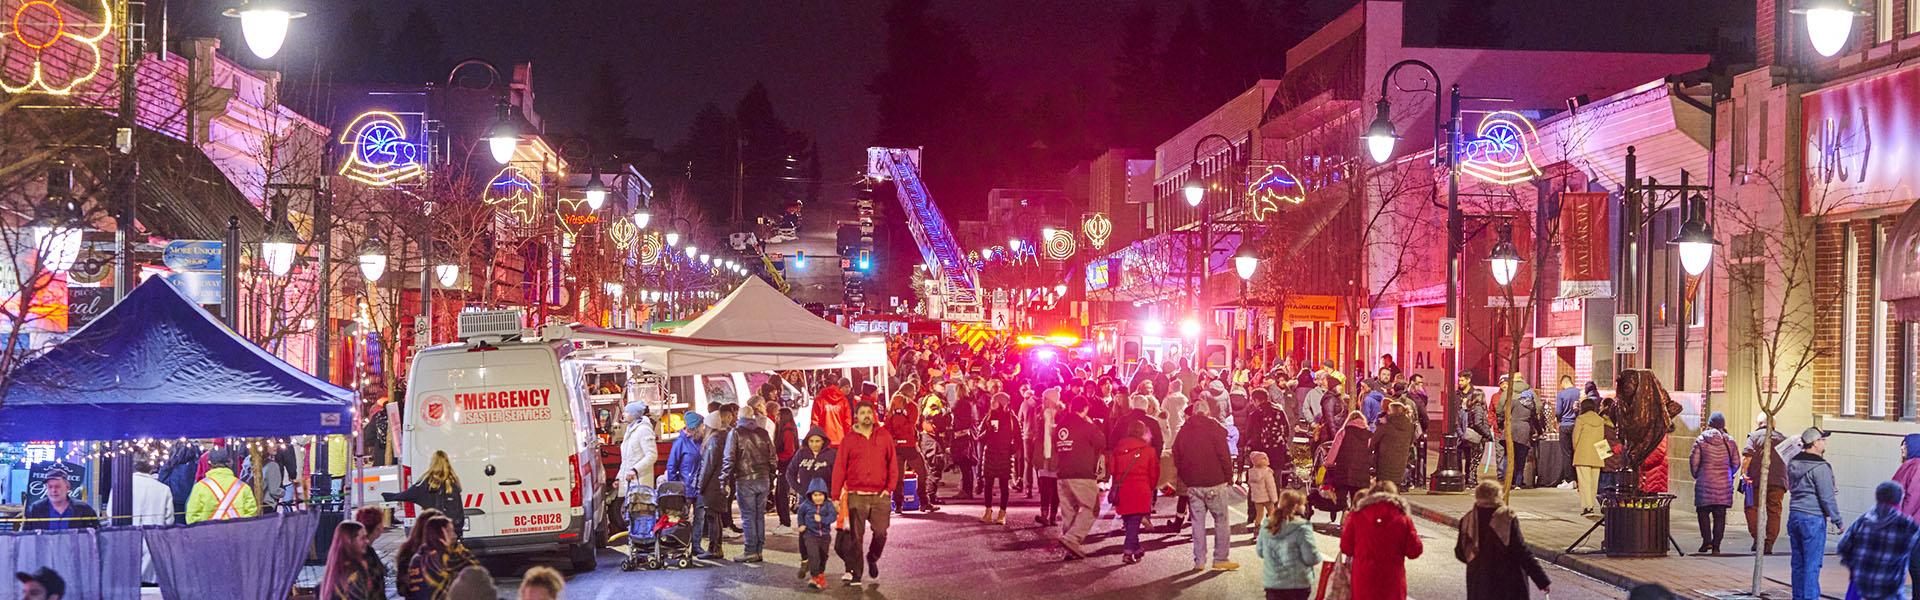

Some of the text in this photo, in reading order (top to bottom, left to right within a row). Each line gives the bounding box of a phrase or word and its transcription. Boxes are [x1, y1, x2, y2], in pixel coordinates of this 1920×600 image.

[1623, 324, 1630, 332] P
[455, 389, 551, 411] EMERGENCY
[505, 408, 551, 422] SERVICES
[514, 513, 562, 526] BC-CRU28
